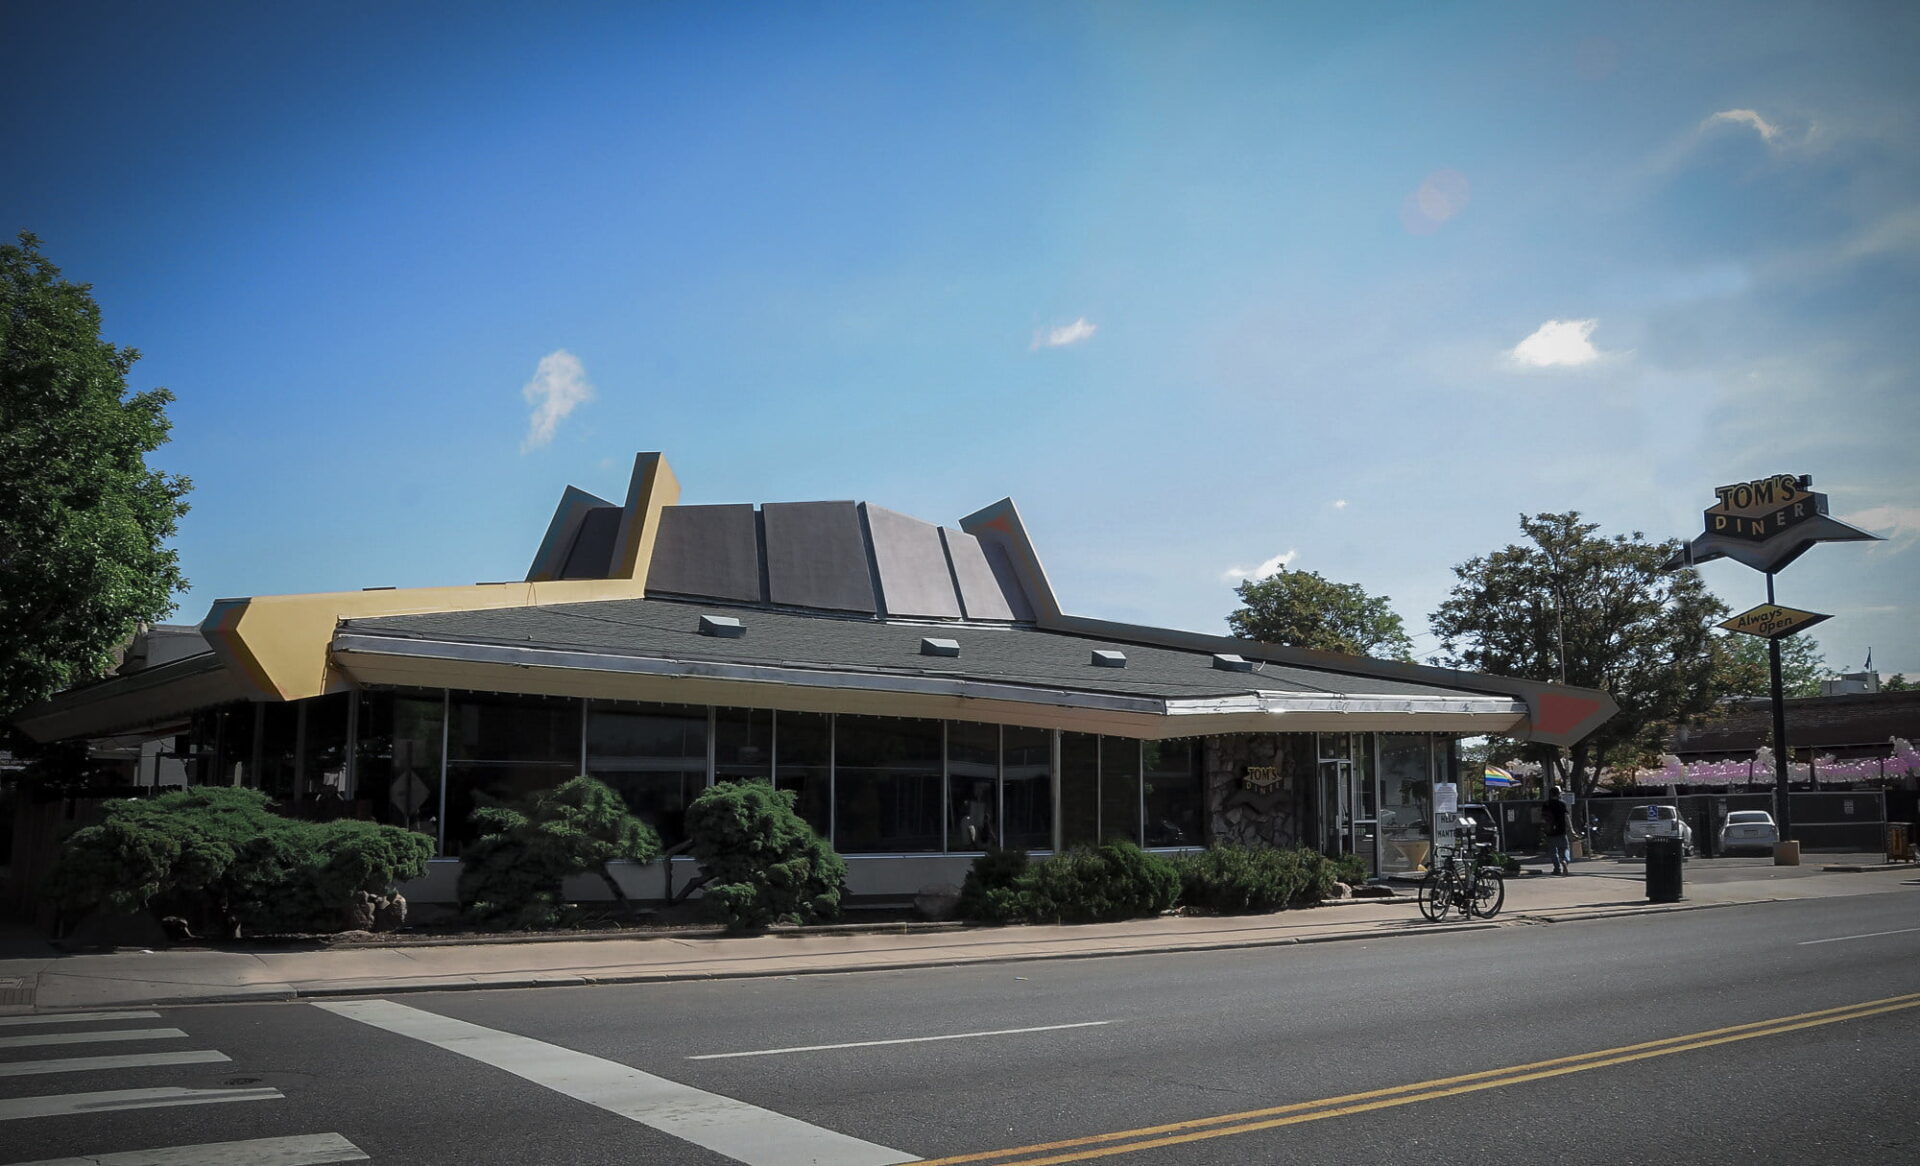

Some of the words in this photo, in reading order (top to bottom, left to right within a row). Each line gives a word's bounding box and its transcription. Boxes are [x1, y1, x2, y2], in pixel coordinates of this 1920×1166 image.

[1716, 475, 1797, 511] TOM'S
[1715, 503, 1804, 535] DINER
[1737, 609, 1783, 628] Always
[1760, 617, 1792, 633] Open
[1248, 767, 1279, 780] TOM'S
[1437, 829, 1456, 838] WANT
